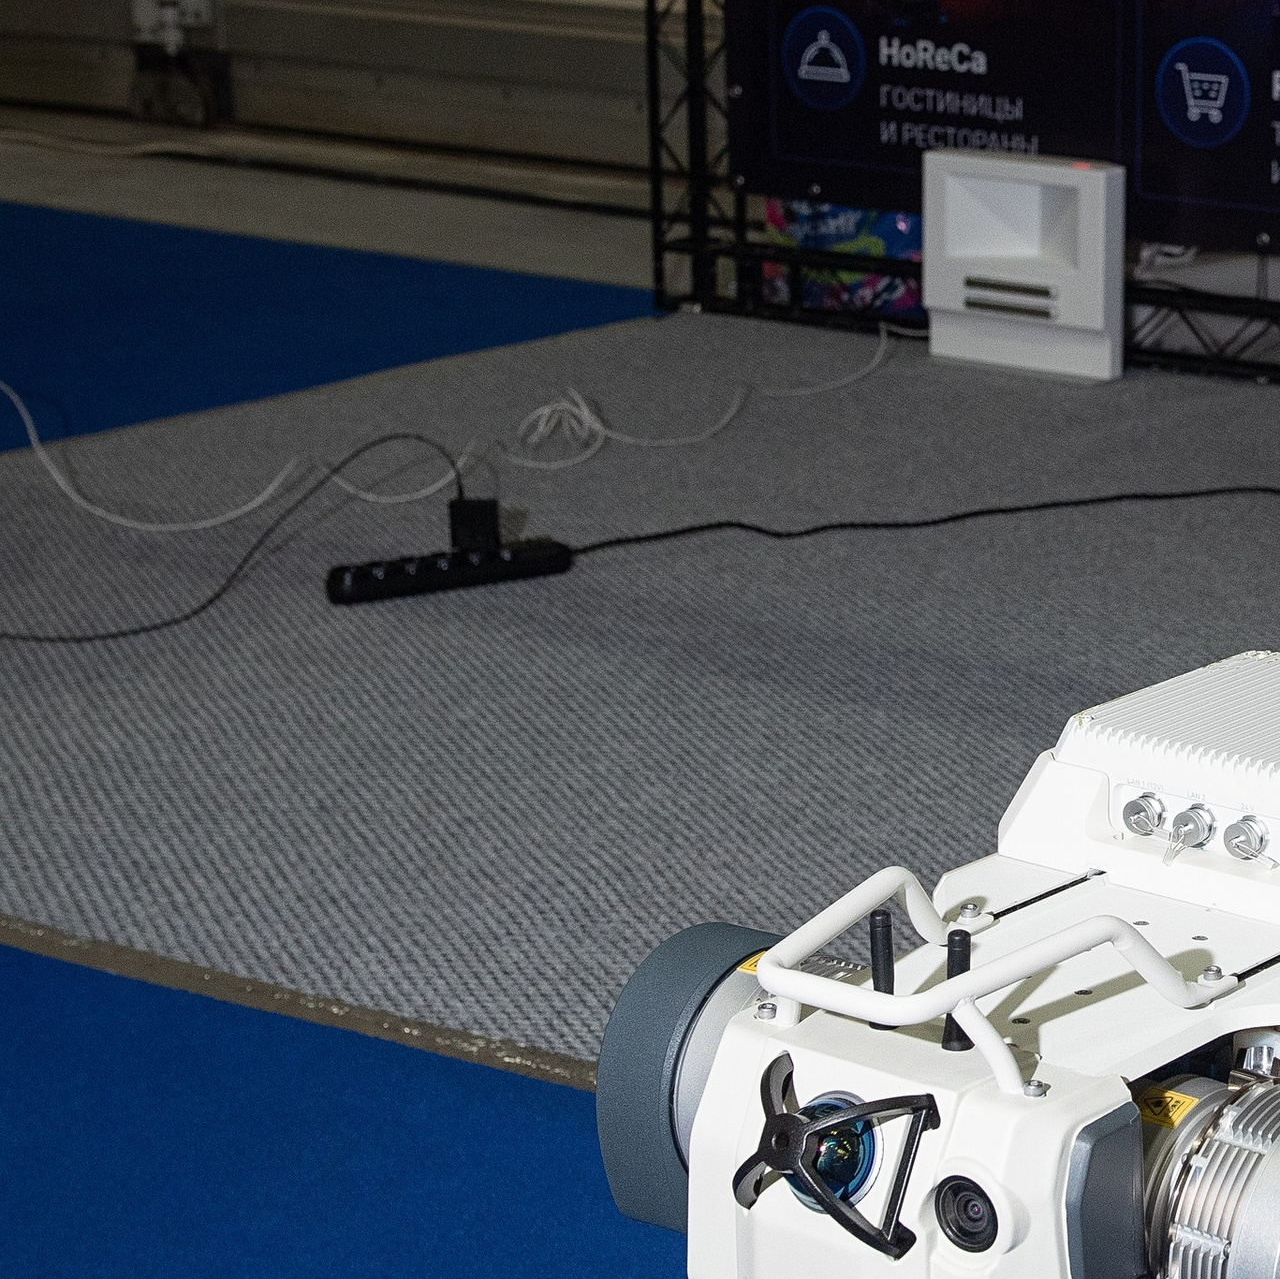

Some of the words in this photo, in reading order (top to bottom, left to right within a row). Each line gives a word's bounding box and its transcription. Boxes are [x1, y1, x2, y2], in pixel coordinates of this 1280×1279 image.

[879, 36, 988, 75] HoReCa
[879, 84, 1024, 123] ГОСТИНИЦЫ
[879, 120, 898, 144] И
